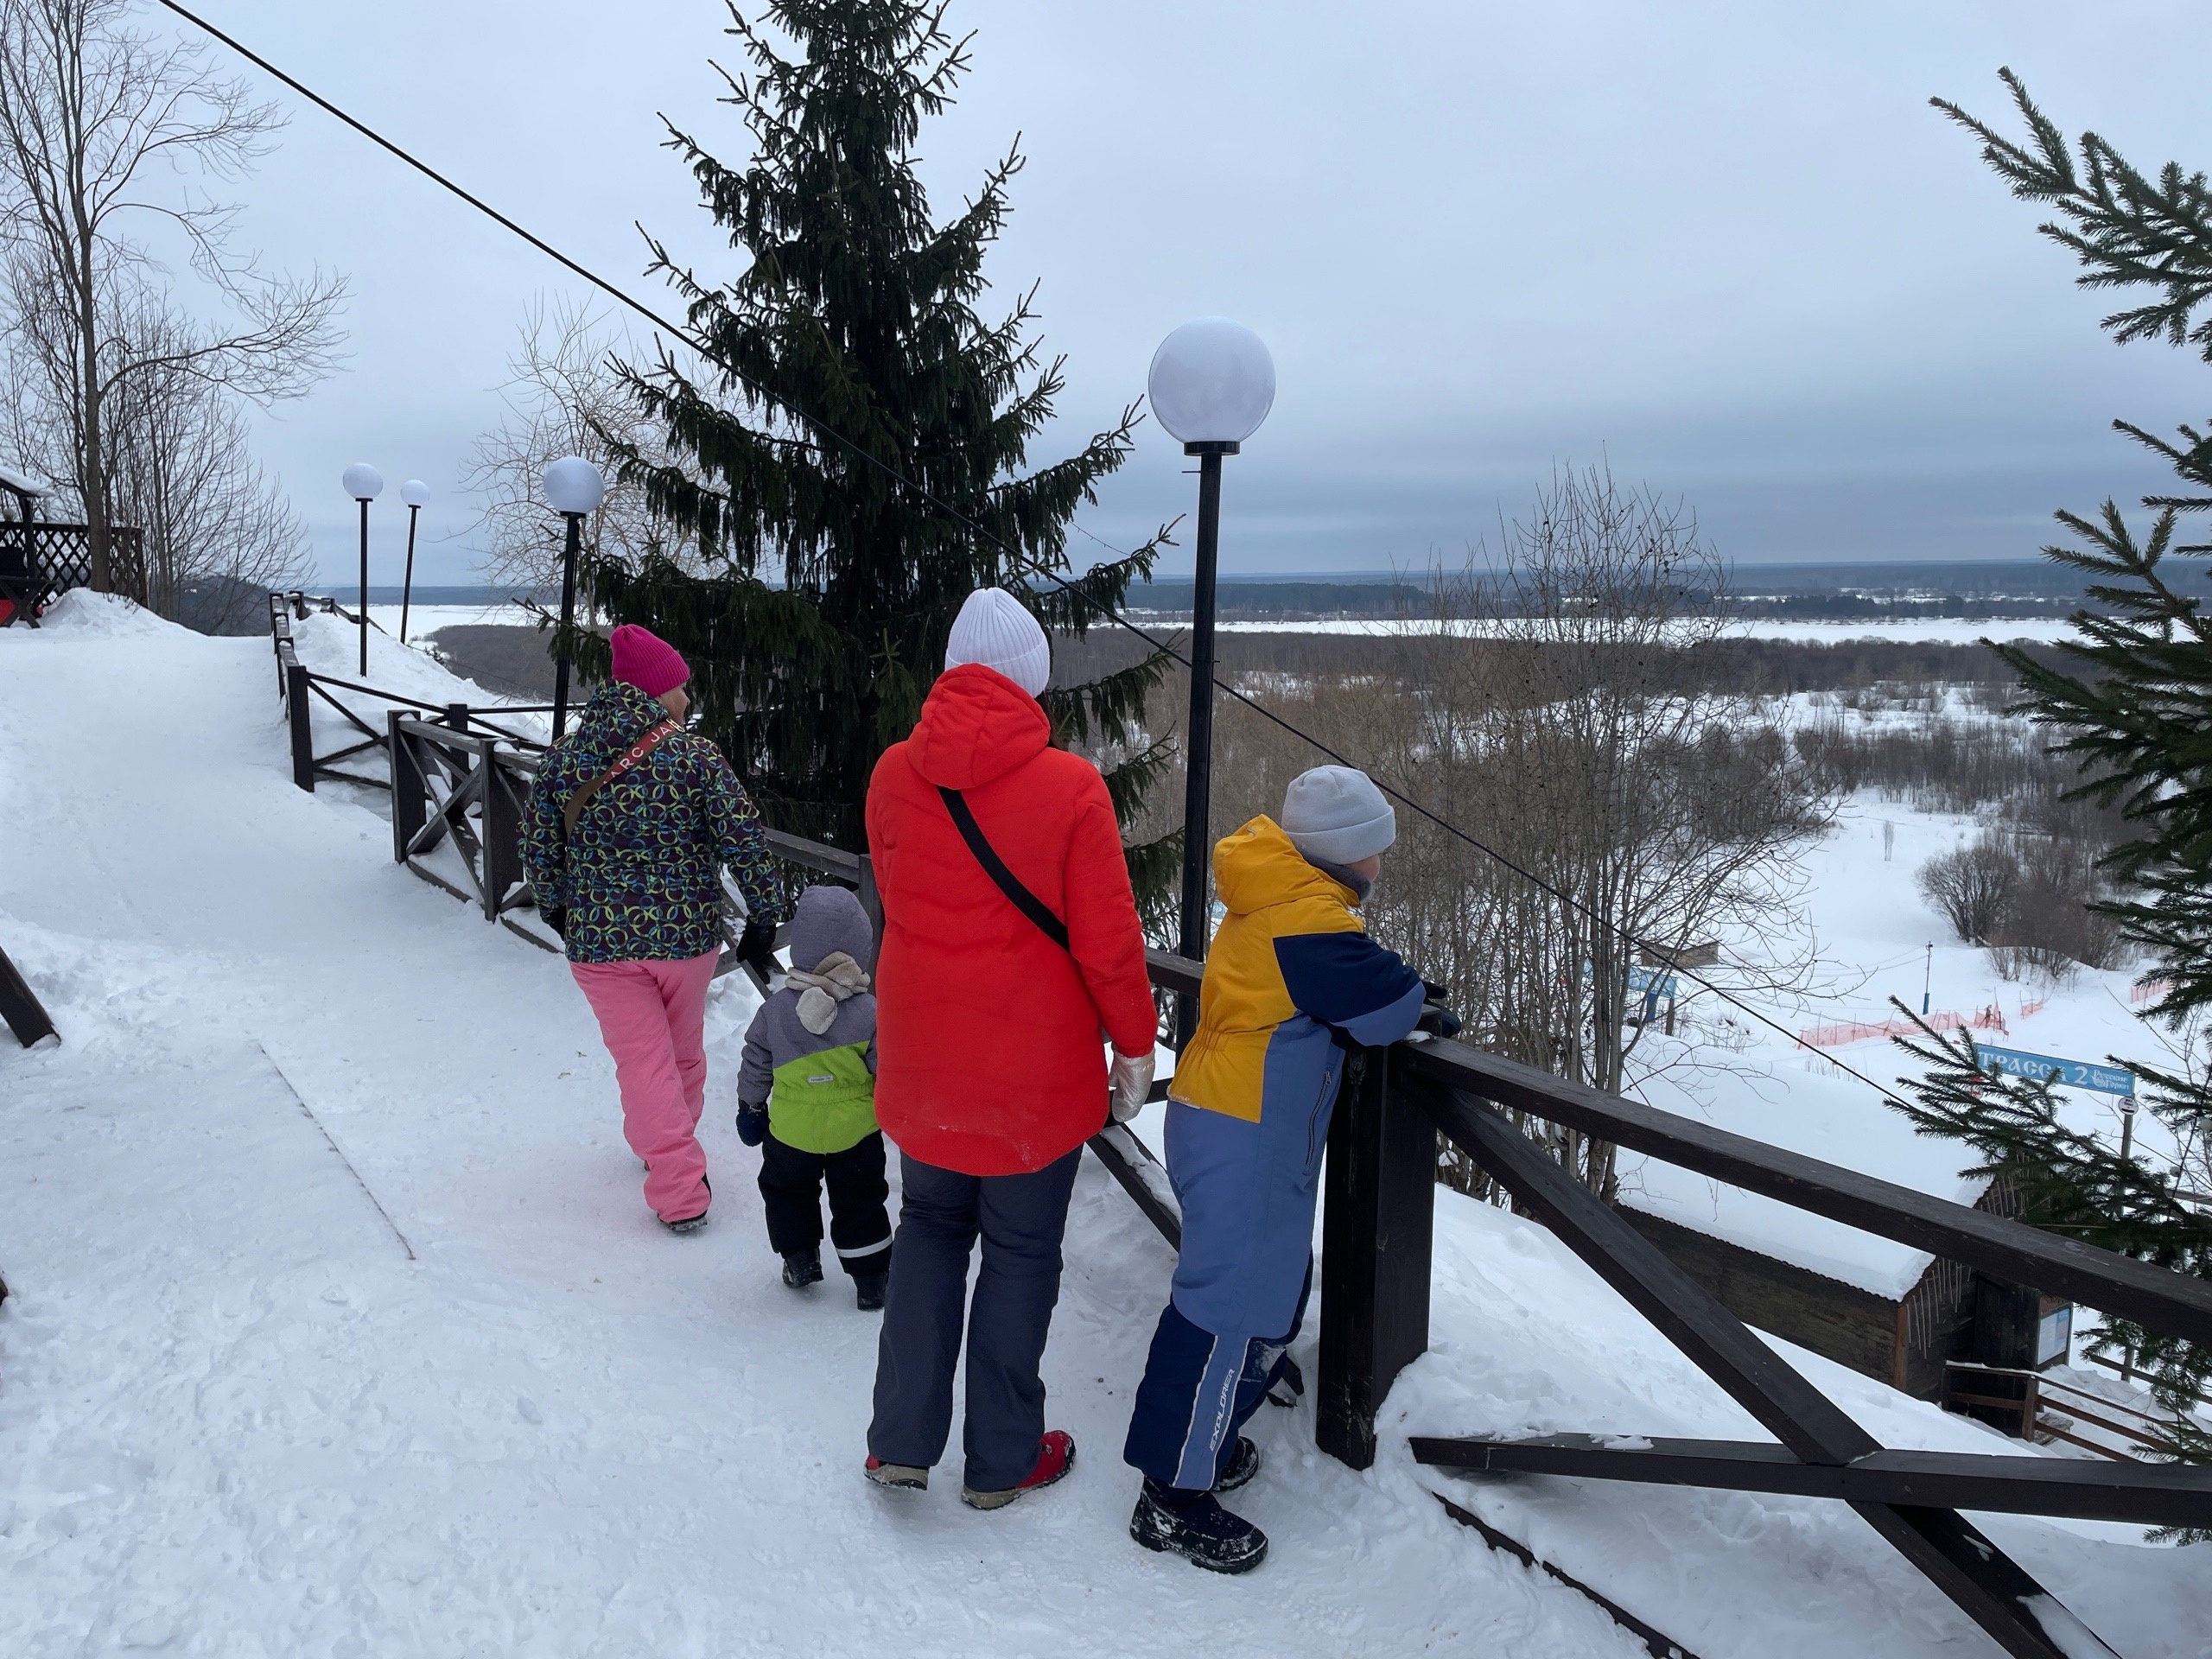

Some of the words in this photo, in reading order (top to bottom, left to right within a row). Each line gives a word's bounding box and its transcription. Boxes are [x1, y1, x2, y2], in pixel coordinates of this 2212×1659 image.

[603, 747, 645, 784] ARC
[2075, 1065, 2089, 1086] 2
[1209, 1369, 1236, 1452] EXPLORER
